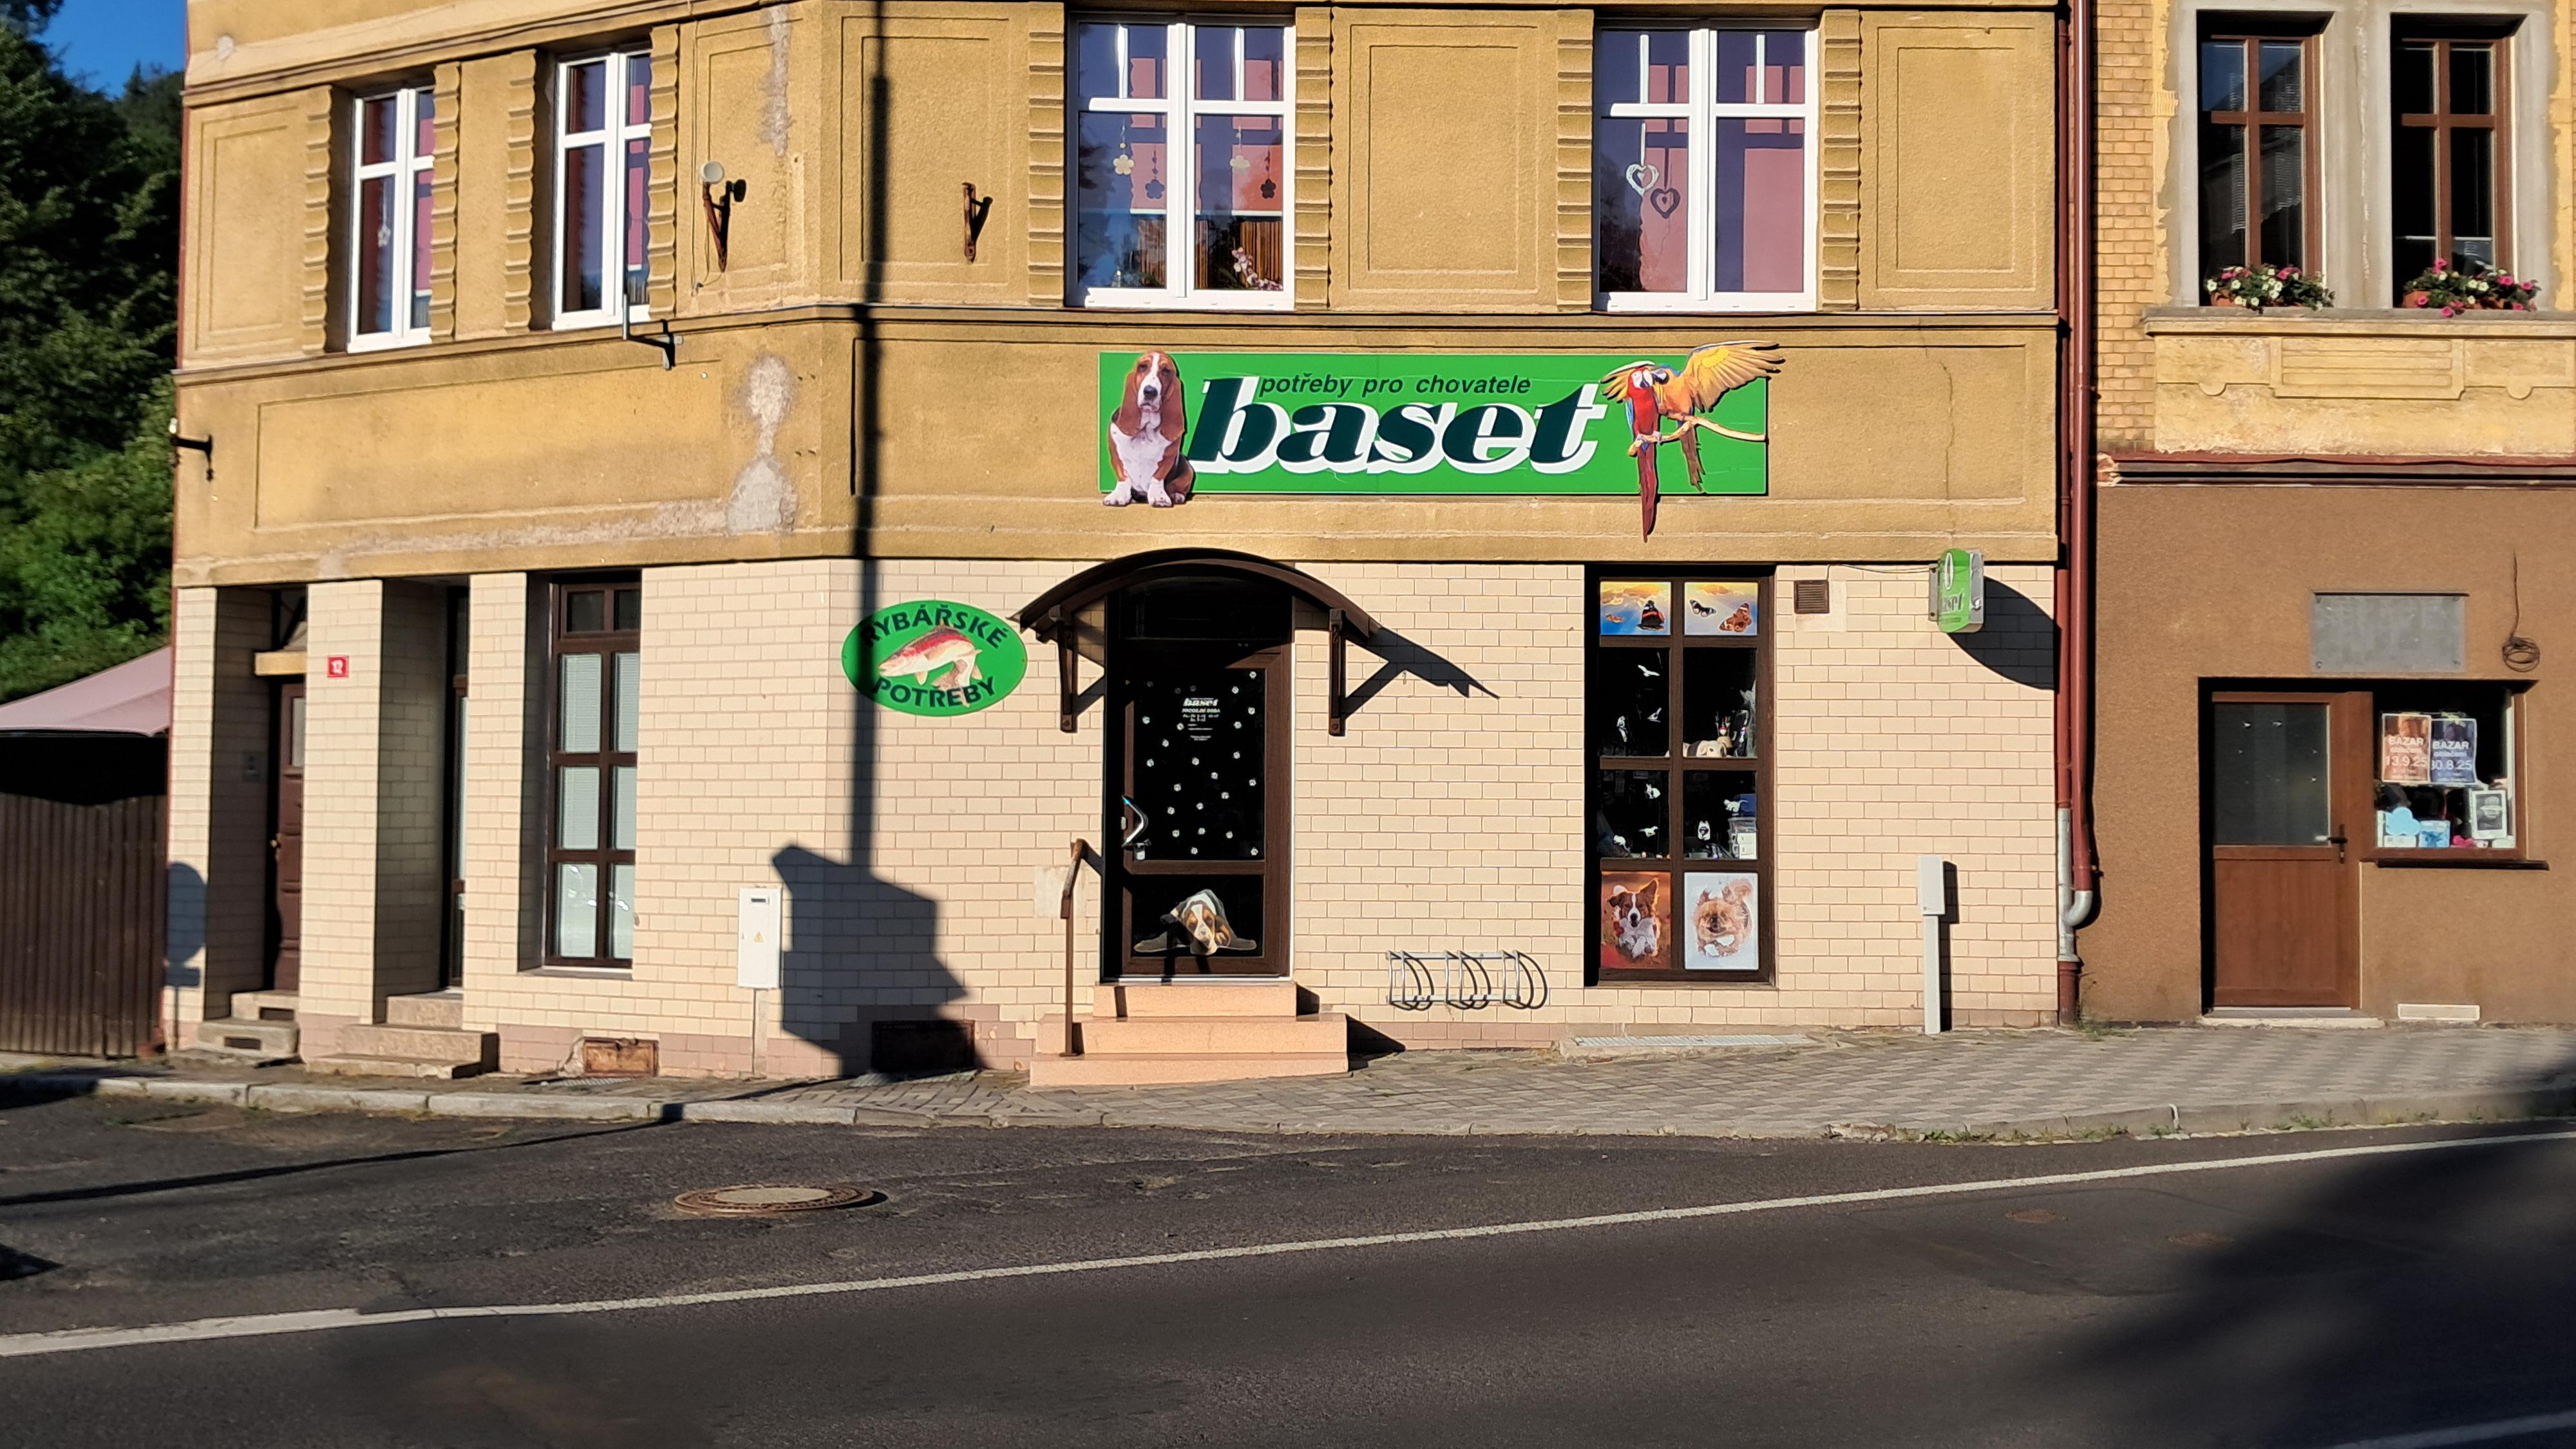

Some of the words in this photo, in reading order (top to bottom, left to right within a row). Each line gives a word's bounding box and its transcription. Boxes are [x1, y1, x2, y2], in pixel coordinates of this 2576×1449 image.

[1259, 372, 1353, 398] potřeby
[1361, 378, 1403, 398] pro
[1416, 375, 1531, 394] chovatele
[1187, 377, 1604, 471] baset
[860, 604, 1009, 649] RYBÁŘSKÉ
[2388, 736, 2424, 746] BAZAR
[2432, 741, 2469, 750] BAZAR
